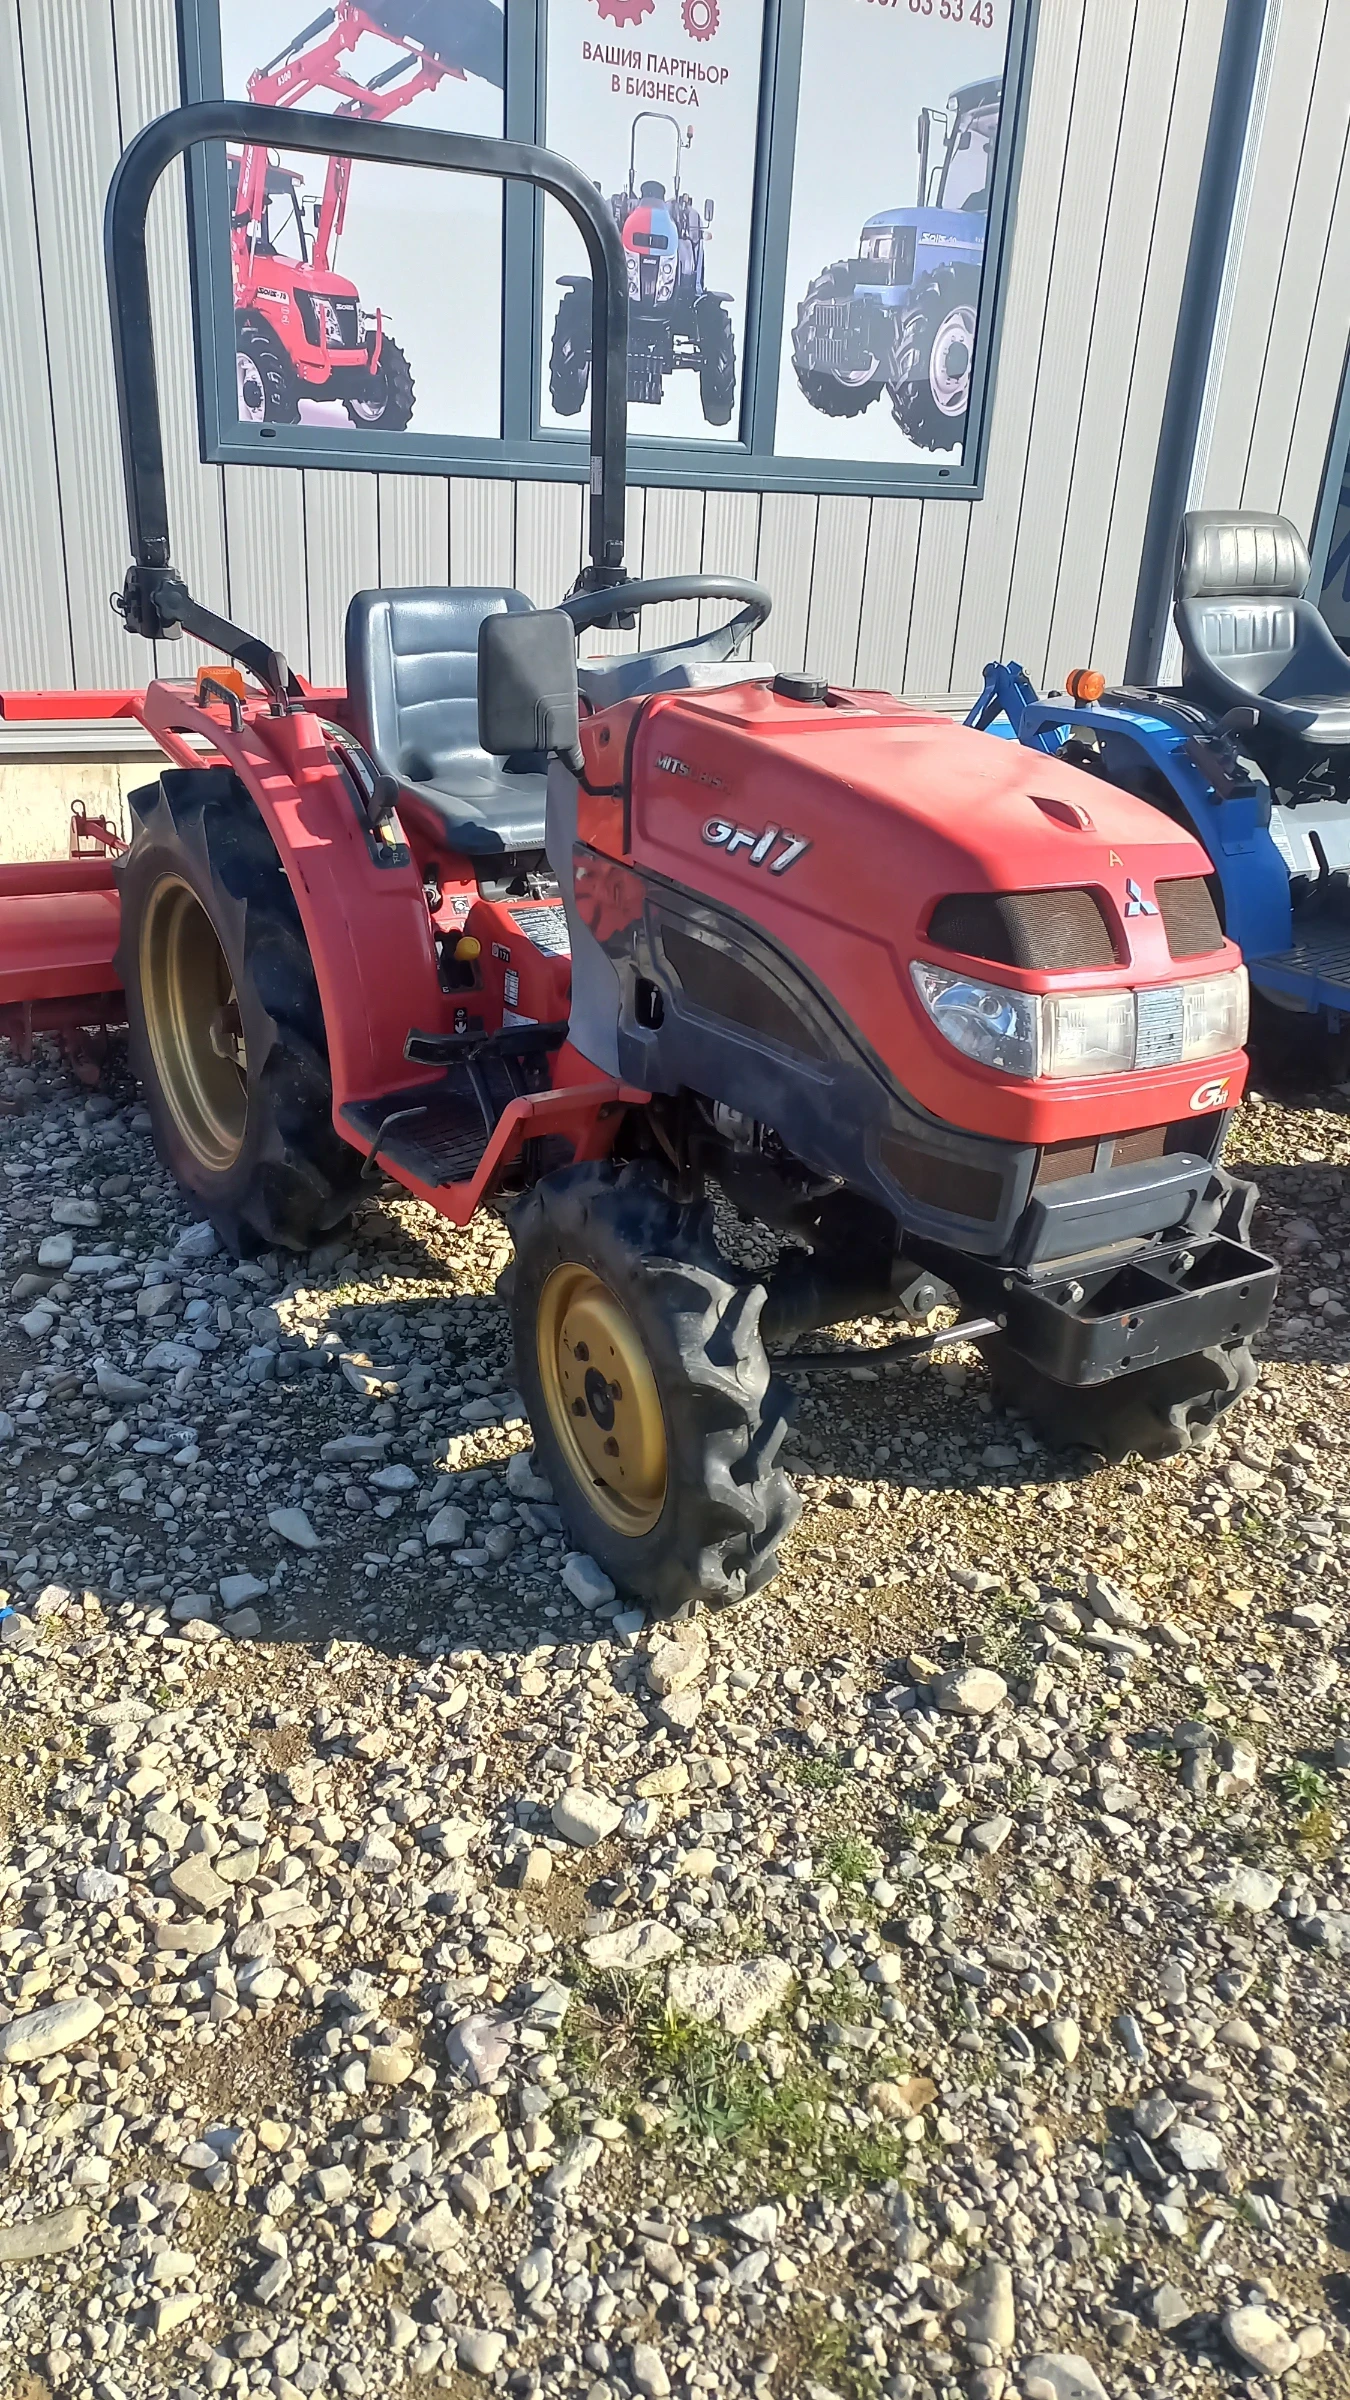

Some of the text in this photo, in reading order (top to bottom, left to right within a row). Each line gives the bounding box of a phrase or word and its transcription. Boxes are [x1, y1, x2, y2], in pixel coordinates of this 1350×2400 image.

[969, 0, 994, 29] 43
[582, 41, 729, 85] ВАШИЯ ПАРТНЬОР
[611, 74, 700, 107] В БИЗНЕСА
[702, 815, 813, 874] GF17
[1109, 849, 1124, 867] A
